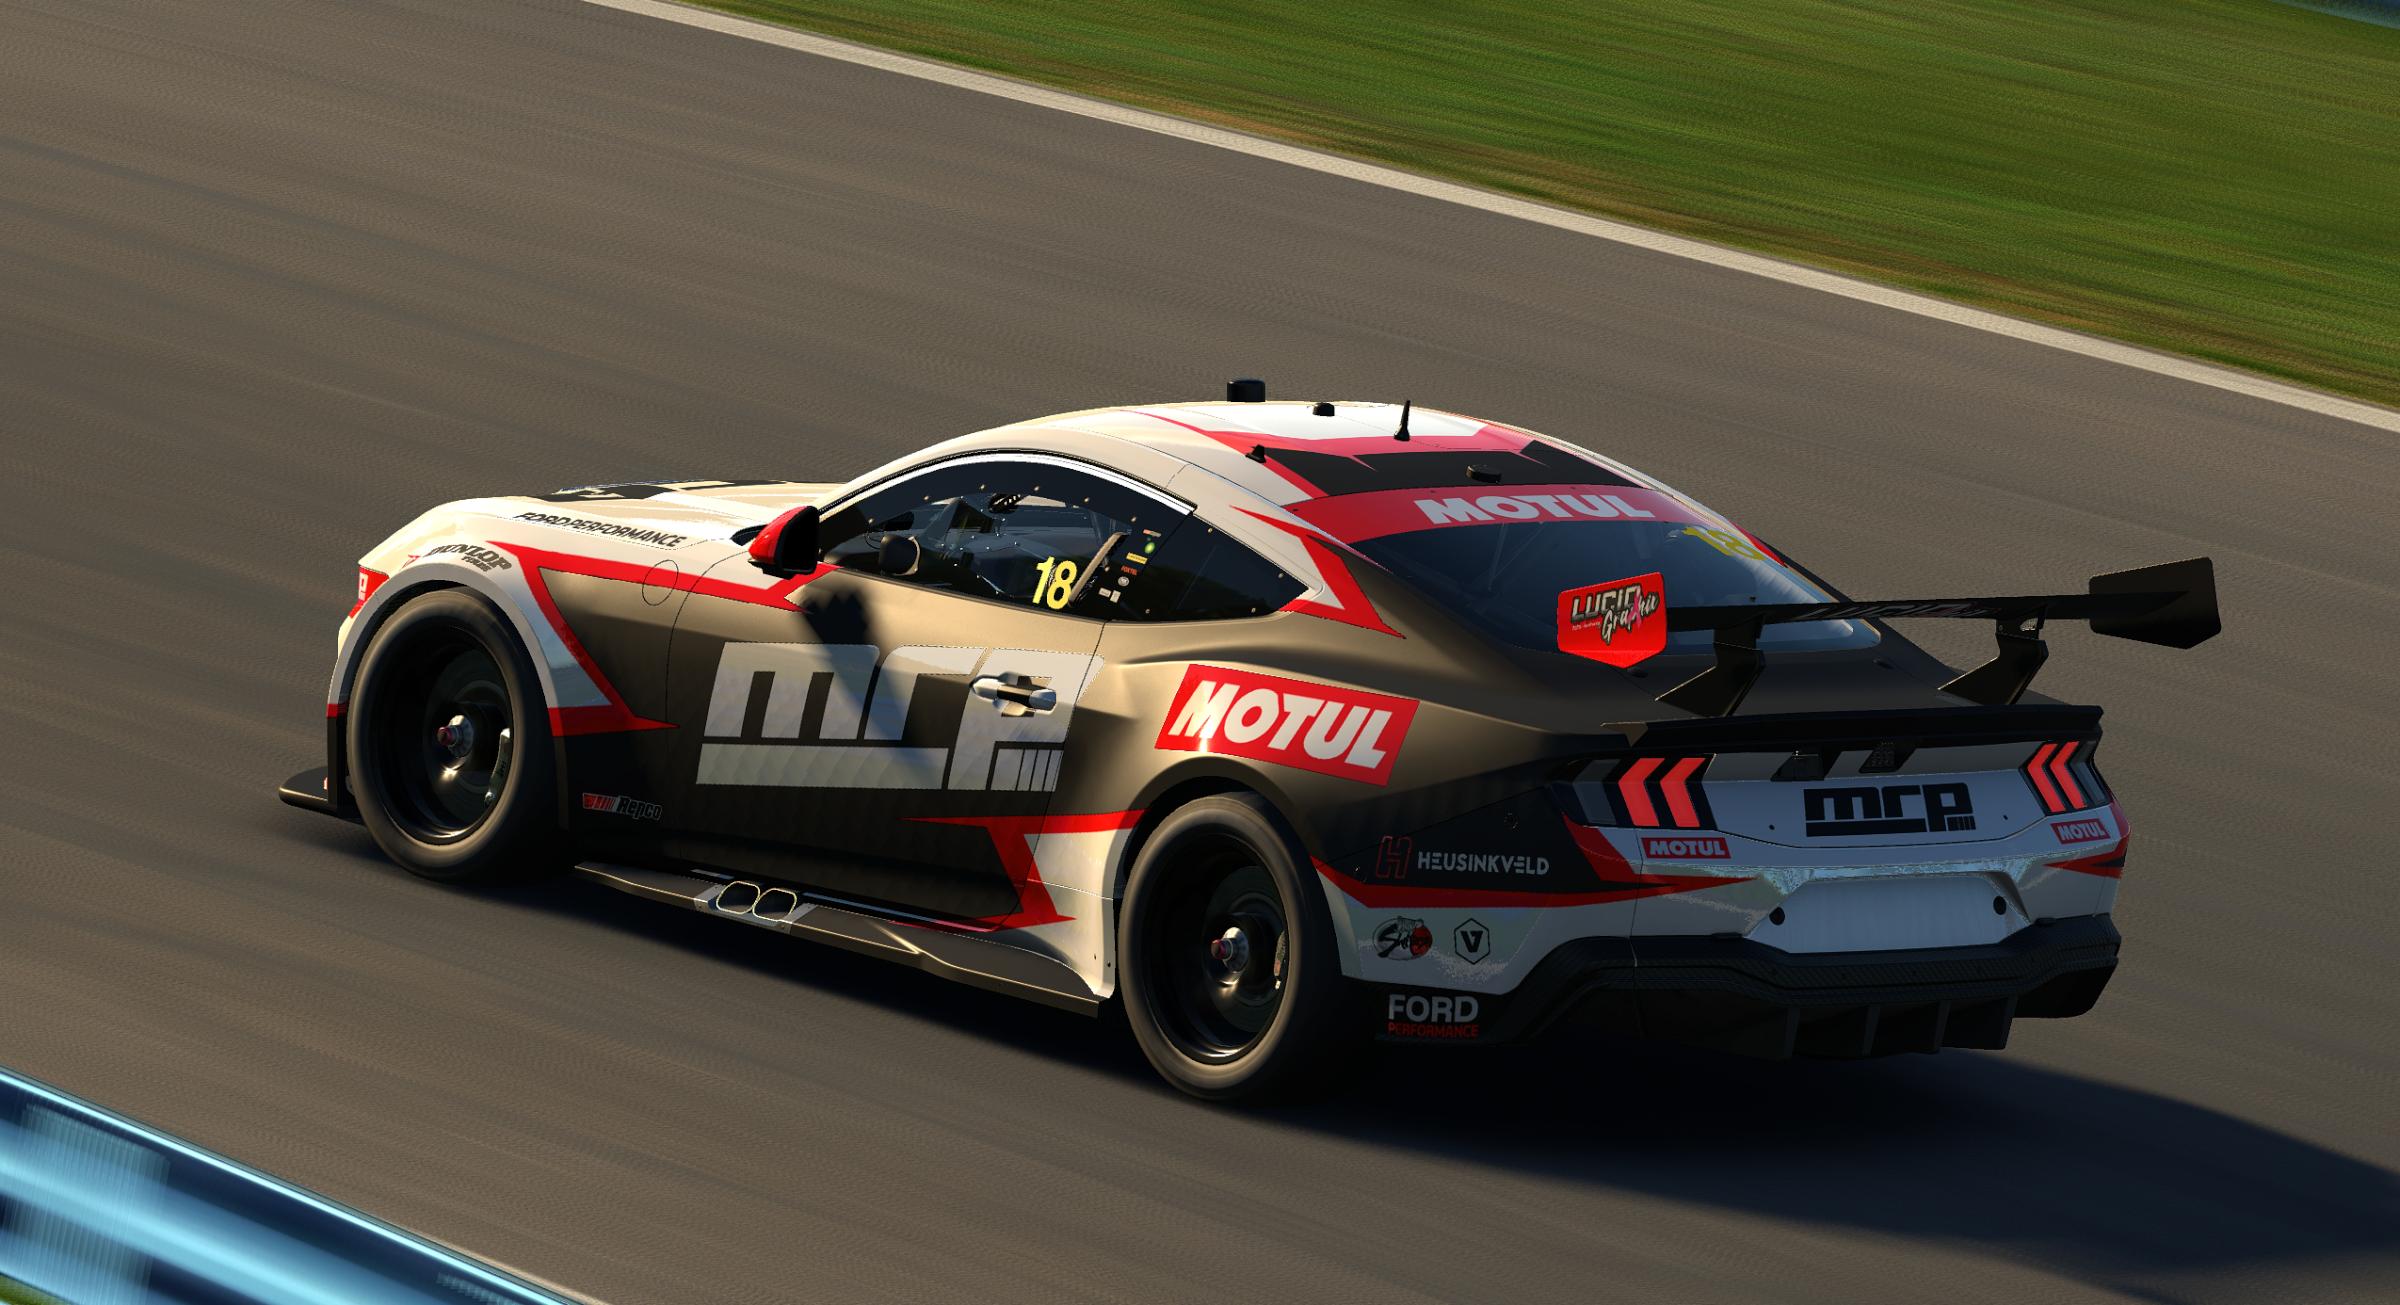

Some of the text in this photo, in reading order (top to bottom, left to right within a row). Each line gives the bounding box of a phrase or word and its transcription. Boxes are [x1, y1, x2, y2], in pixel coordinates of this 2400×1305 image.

[1415, 494, 1656, 525] MOTUL
[513, 512, 688, 548] FORD PERFORMANCE
[1682, 526, 1766, 561] 18
[428, 543, 513, 571] DUNLOP
[1032, 556, 1078, 610] 18
[1571, 584, 1642, 621] LUCID
[1167, 680, 1393, 769] MOTUL
[616, 795, 663, 821] Repco
[2057, 821, 2105, 841] MOTUL
[1649, 840, 1726, 856] MOTUL
[1417, 851, 1550, 875] HEUSINKVELD
[1388, 994, 1479, 1023] FORD
[1387, 1022, 1480, 1038] PERFORMANCE
